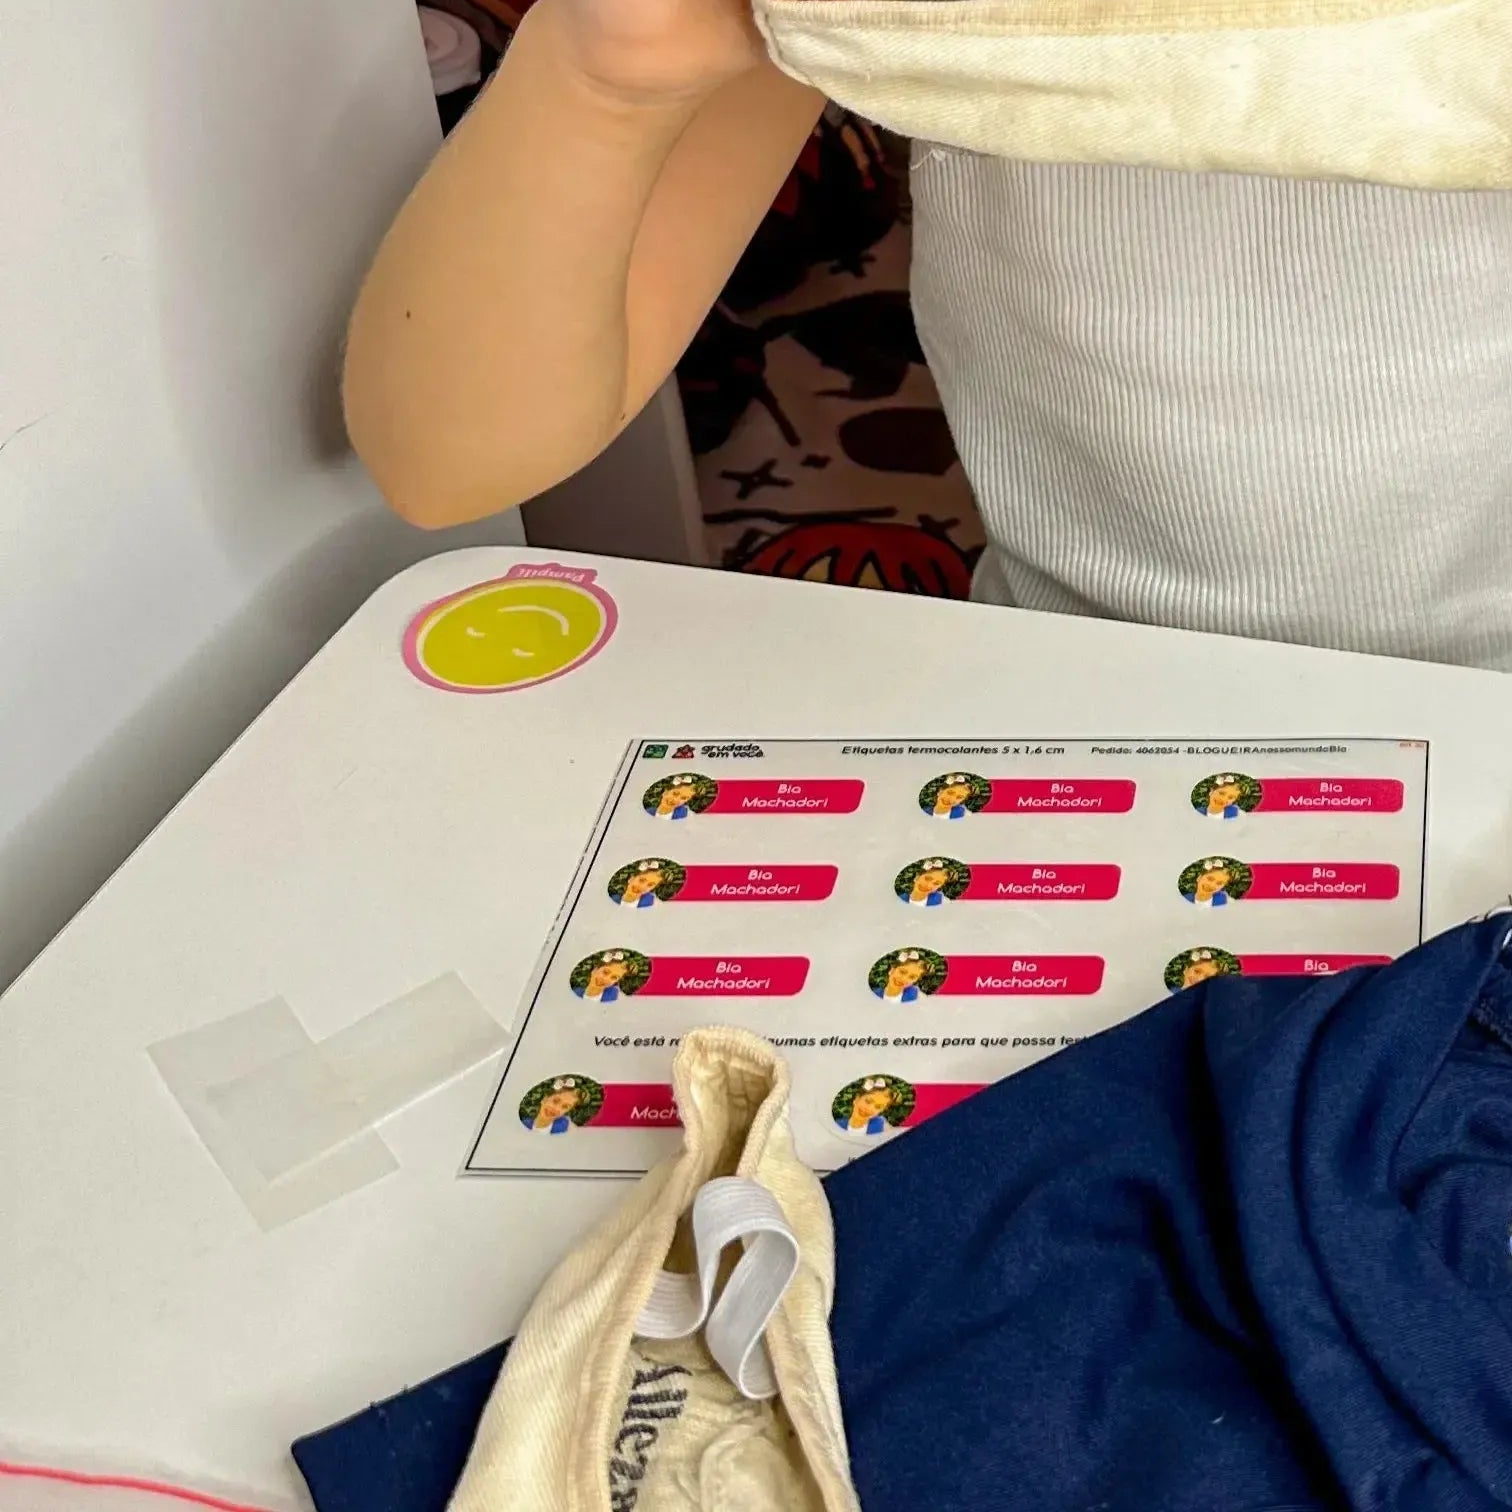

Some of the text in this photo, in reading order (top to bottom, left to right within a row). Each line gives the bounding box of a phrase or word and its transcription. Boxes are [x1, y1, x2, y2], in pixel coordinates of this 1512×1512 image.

[518, 567, 586, 583] Pampili
[701, 743, 761, 757] grudado
[707, 748, 764, 759] em você
[841, 745, 905, 756] Etiquetas
[907, 744, 999, 755] termocolantes
[1001, 745, 1010, 755] 5
[1045, 747, 1066, 755] cm
[1090, 745, 1133, 755] Pedido:
[777, 783, 802, 794] Bia
[1050, 783, 1075, 794] Bia
[1319, 782, 1343, 793] Bia
[742, 797, 829, 809] Machadori
[1016, 796, 1103, 808] Machadori
[1288, 795, 1372, 807] Machadori
[747, 869, 773, 881] Bia
[1031, 868, 1057, 880] Bia
[1312, 867, 1337, 879] Bia
[710, 883, 801, 896] Machadori
[997, 882, 1086, 895] Machadori
[1279, 881, 1367, 894] Machadori
[715, 961, 742, 974] Bia
[1011, 960, 1038, 973] Bia
[1304, 959, 1329, 972] Bia
[676, 977, 771, 990] Machadori
[975, 976, 1068, 989] Machadori
[594, 1035, 631, 1048] Você
[633, 1035, 666, 1048] está
[819, 1035, 889, 1049] etiquetas
[892, 1036, 938, 1047] extras
[941, 1038, 976, 1049] para
[980, 1038, 1009, 1049] que
[1011, 1038, 1056, 1049] possa
